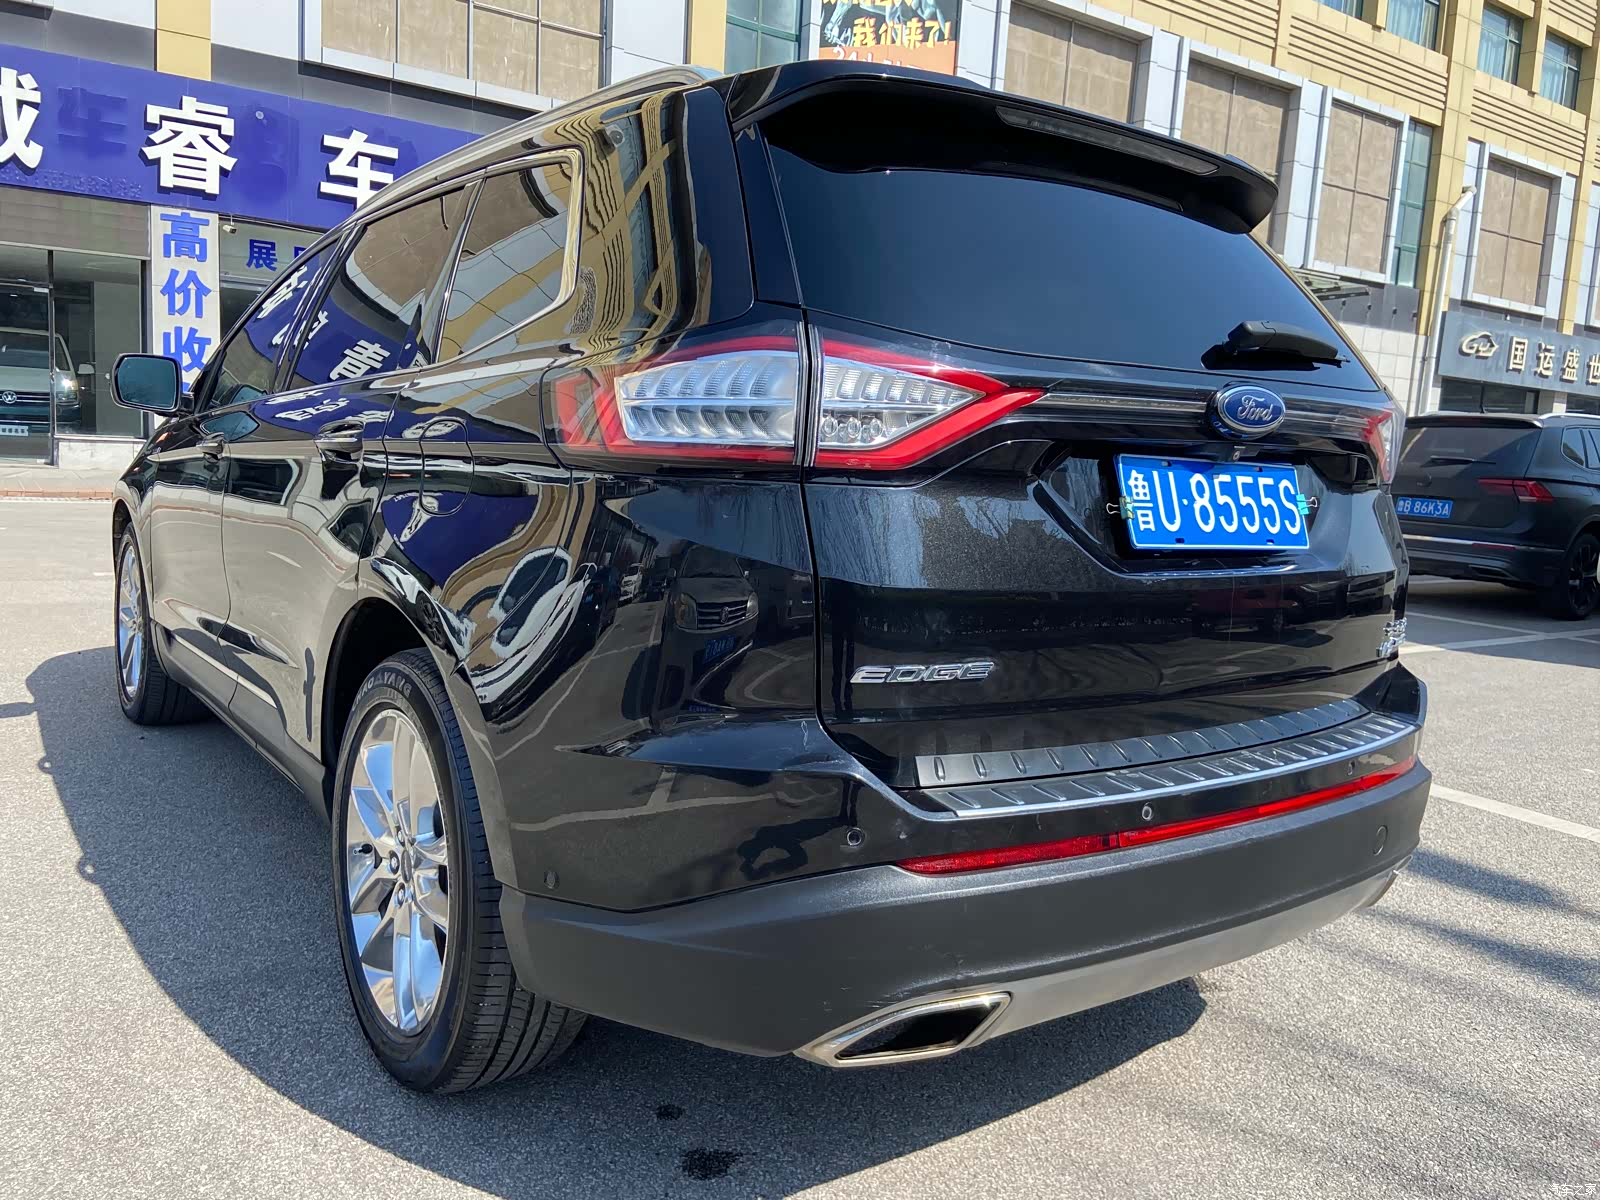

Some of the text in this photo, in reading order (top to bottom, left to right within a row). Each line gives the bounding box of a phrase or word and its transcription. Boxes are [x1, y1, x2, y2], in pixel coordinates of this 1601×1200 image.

[160, 212, 212, 393] 高价收
[1237, 394, 1273, 422] Ford
[850, 661, 995, 683] EDGE
